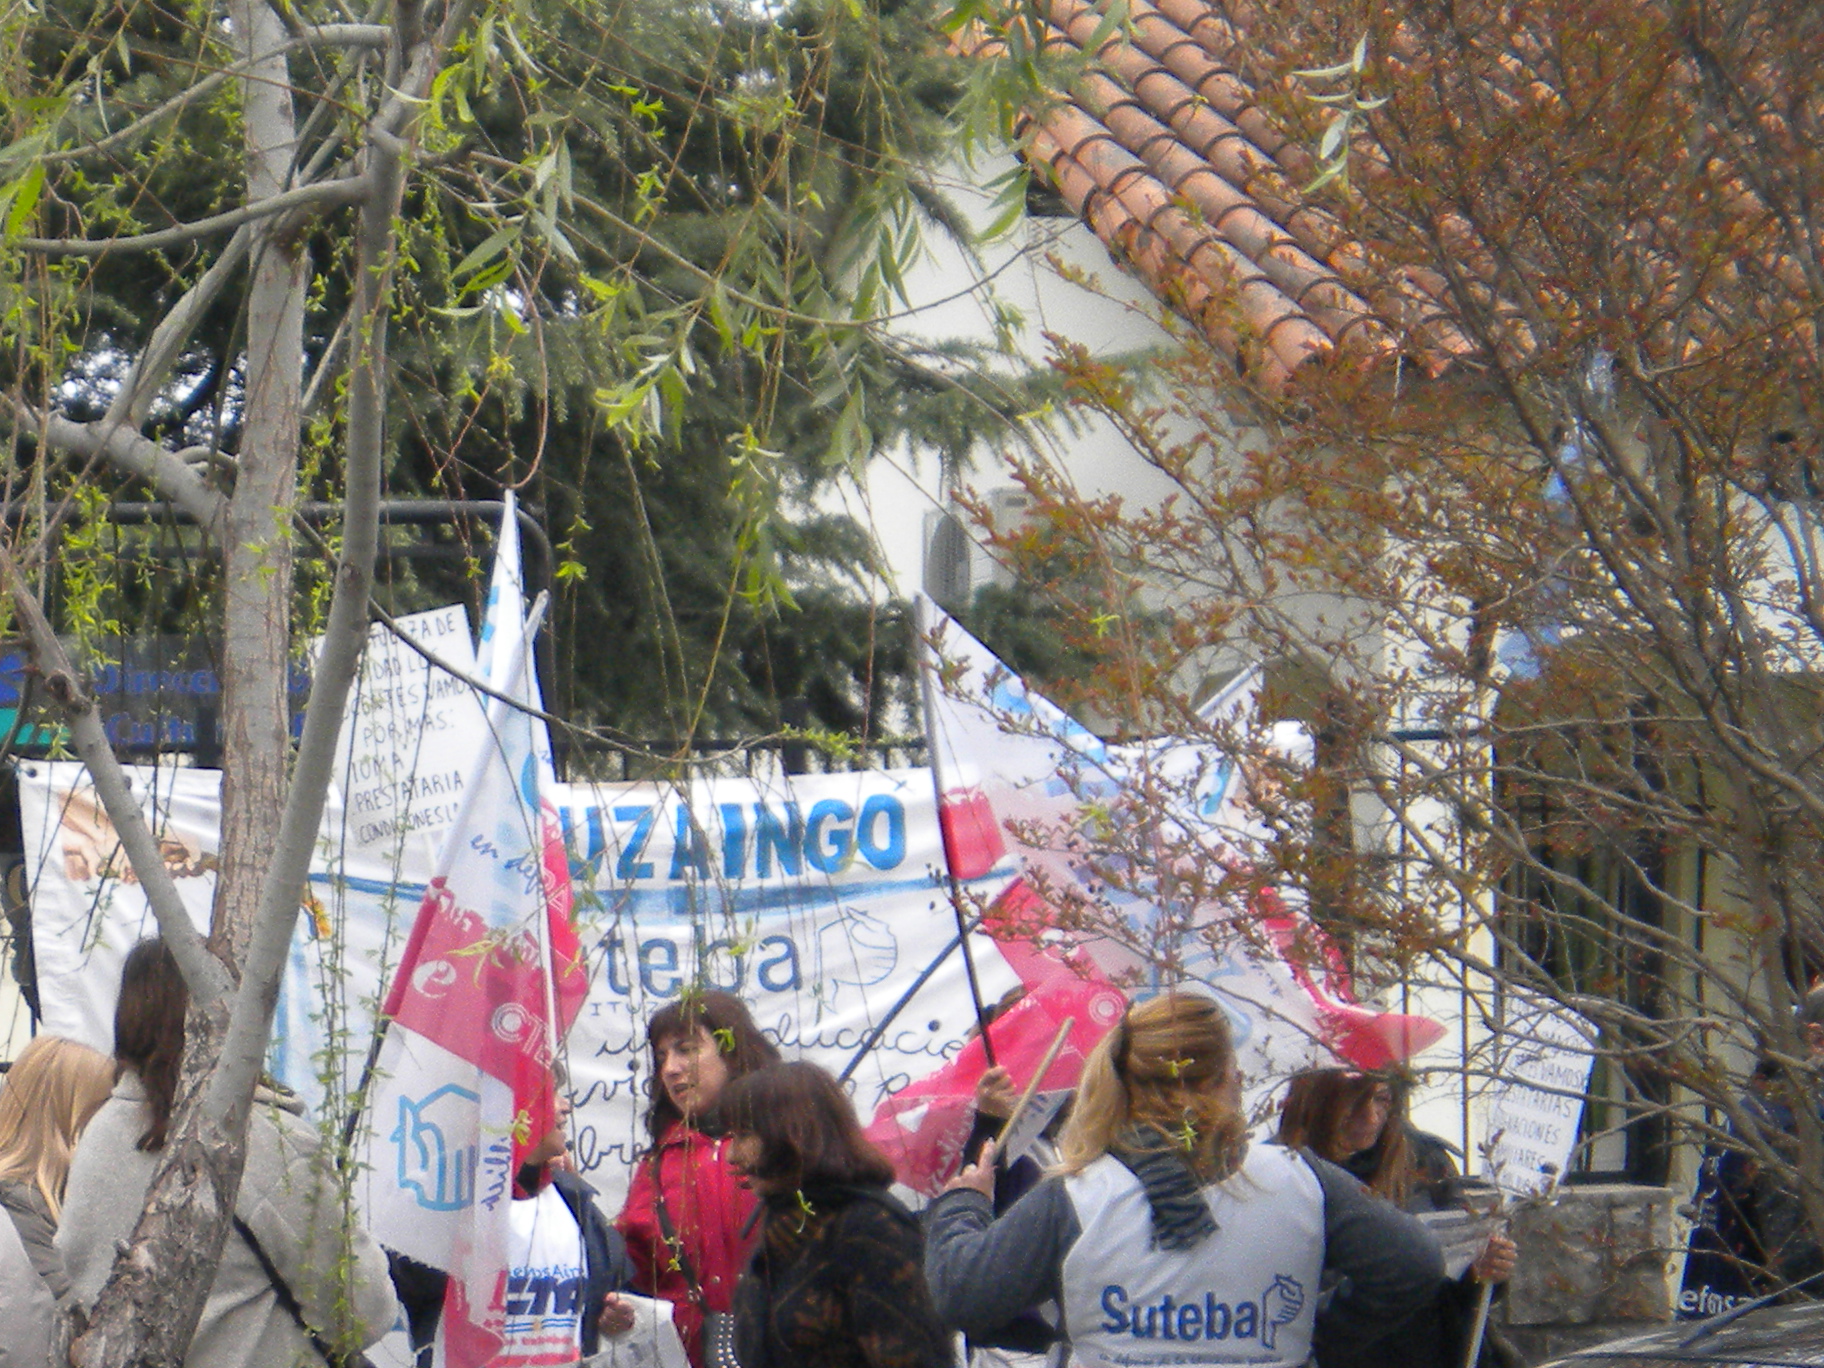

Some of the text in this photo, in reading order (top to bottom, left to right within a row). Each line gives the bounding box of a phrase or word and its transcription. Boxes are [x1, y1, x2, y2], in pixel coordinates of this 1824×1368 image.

[435, 612, 457, 636] DE
[598, 925, 804, 1000] teba
[1101, 1284, 1259, 1342] Suteba
